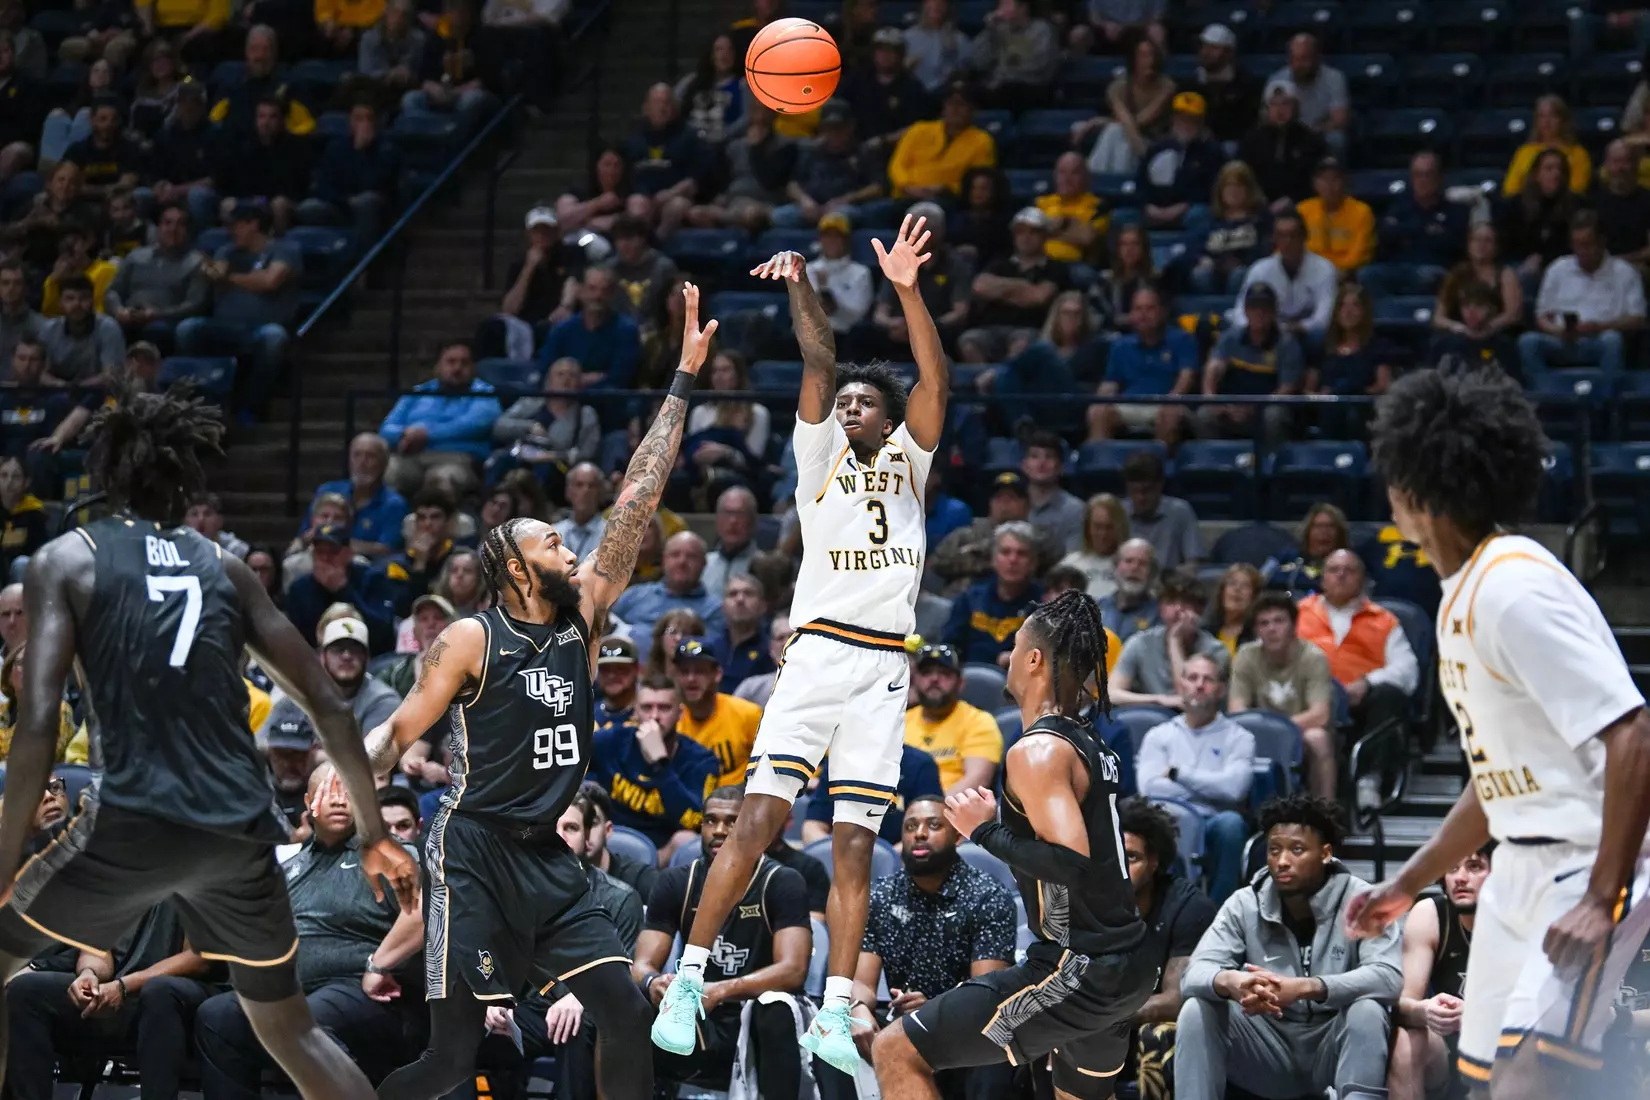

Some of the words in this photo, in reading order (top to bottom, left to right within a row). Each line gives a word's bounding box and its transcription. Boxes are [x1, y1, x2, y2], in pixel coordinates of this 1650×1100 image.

[836, 470, 904, 495] WEST
[866, 499, 888, 545] 3
[145, 535, 190, 567] BOL
[145, 574, 203, 667] 7
[517, 667, 574, 718] UCF
[533, 723, 581, 770] 99
[1109, 793, 1129, 880] 1
